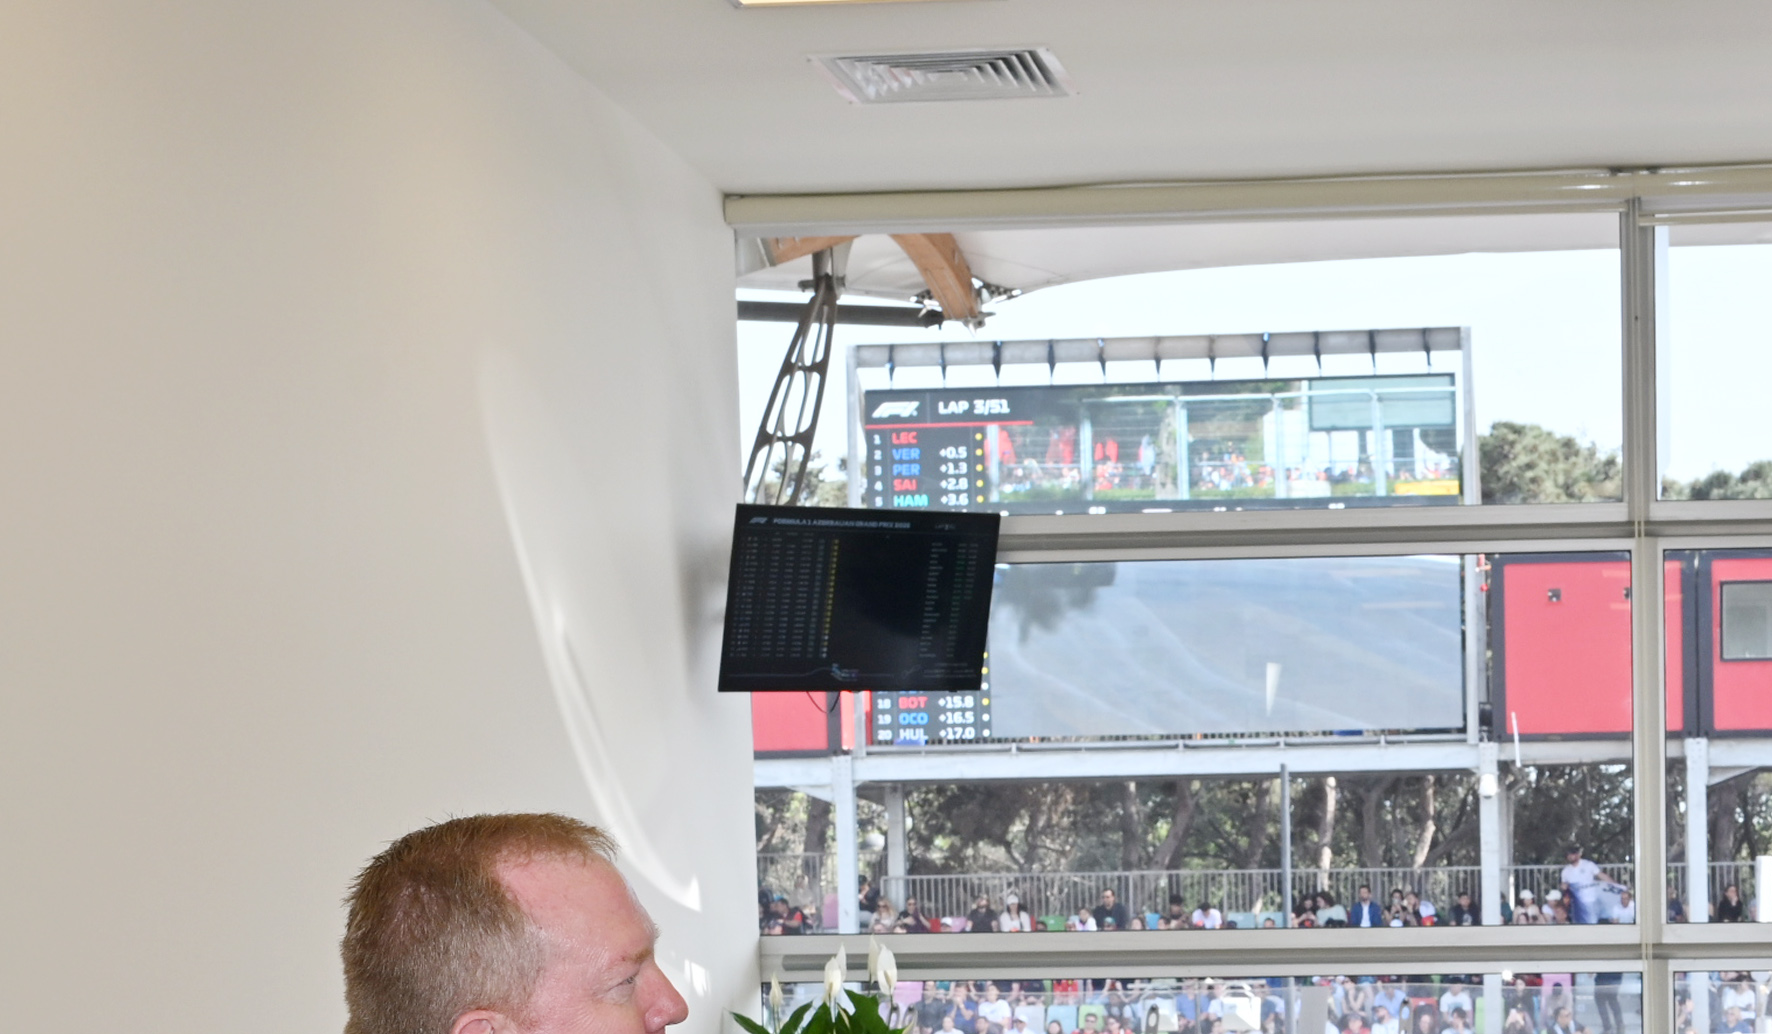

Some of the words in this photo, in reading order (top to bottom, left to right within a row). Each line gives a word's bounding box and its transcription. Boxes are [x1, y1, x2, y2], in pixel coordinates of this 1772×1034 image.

[938, 401, 969, 415] LAP
[973, 399, 1010, 415] 3/51
[873, 434, 881, 445] 1
[892, 431, 918, 444] LEC
[874, 450, 882, 460] 2
[892, 448, 921, 461] VER
[874, 465, 882, 476] 3
[892, 463, 921, 476] PER
[874, 481, 883, 491] 4
[893, 478, 918, 491] SAI
[875, 496, 883, 507] 5
[893, 494, 929, 507] HAM
[877, 698, 892, 709] 18
[898, 696, 928, 709] BOT
[877, 714, 892, 725] 19
[898, 712, 929, 725] OCO
[877, 729, 893, 740] 20
[899, 728, 929, 740] HUL
